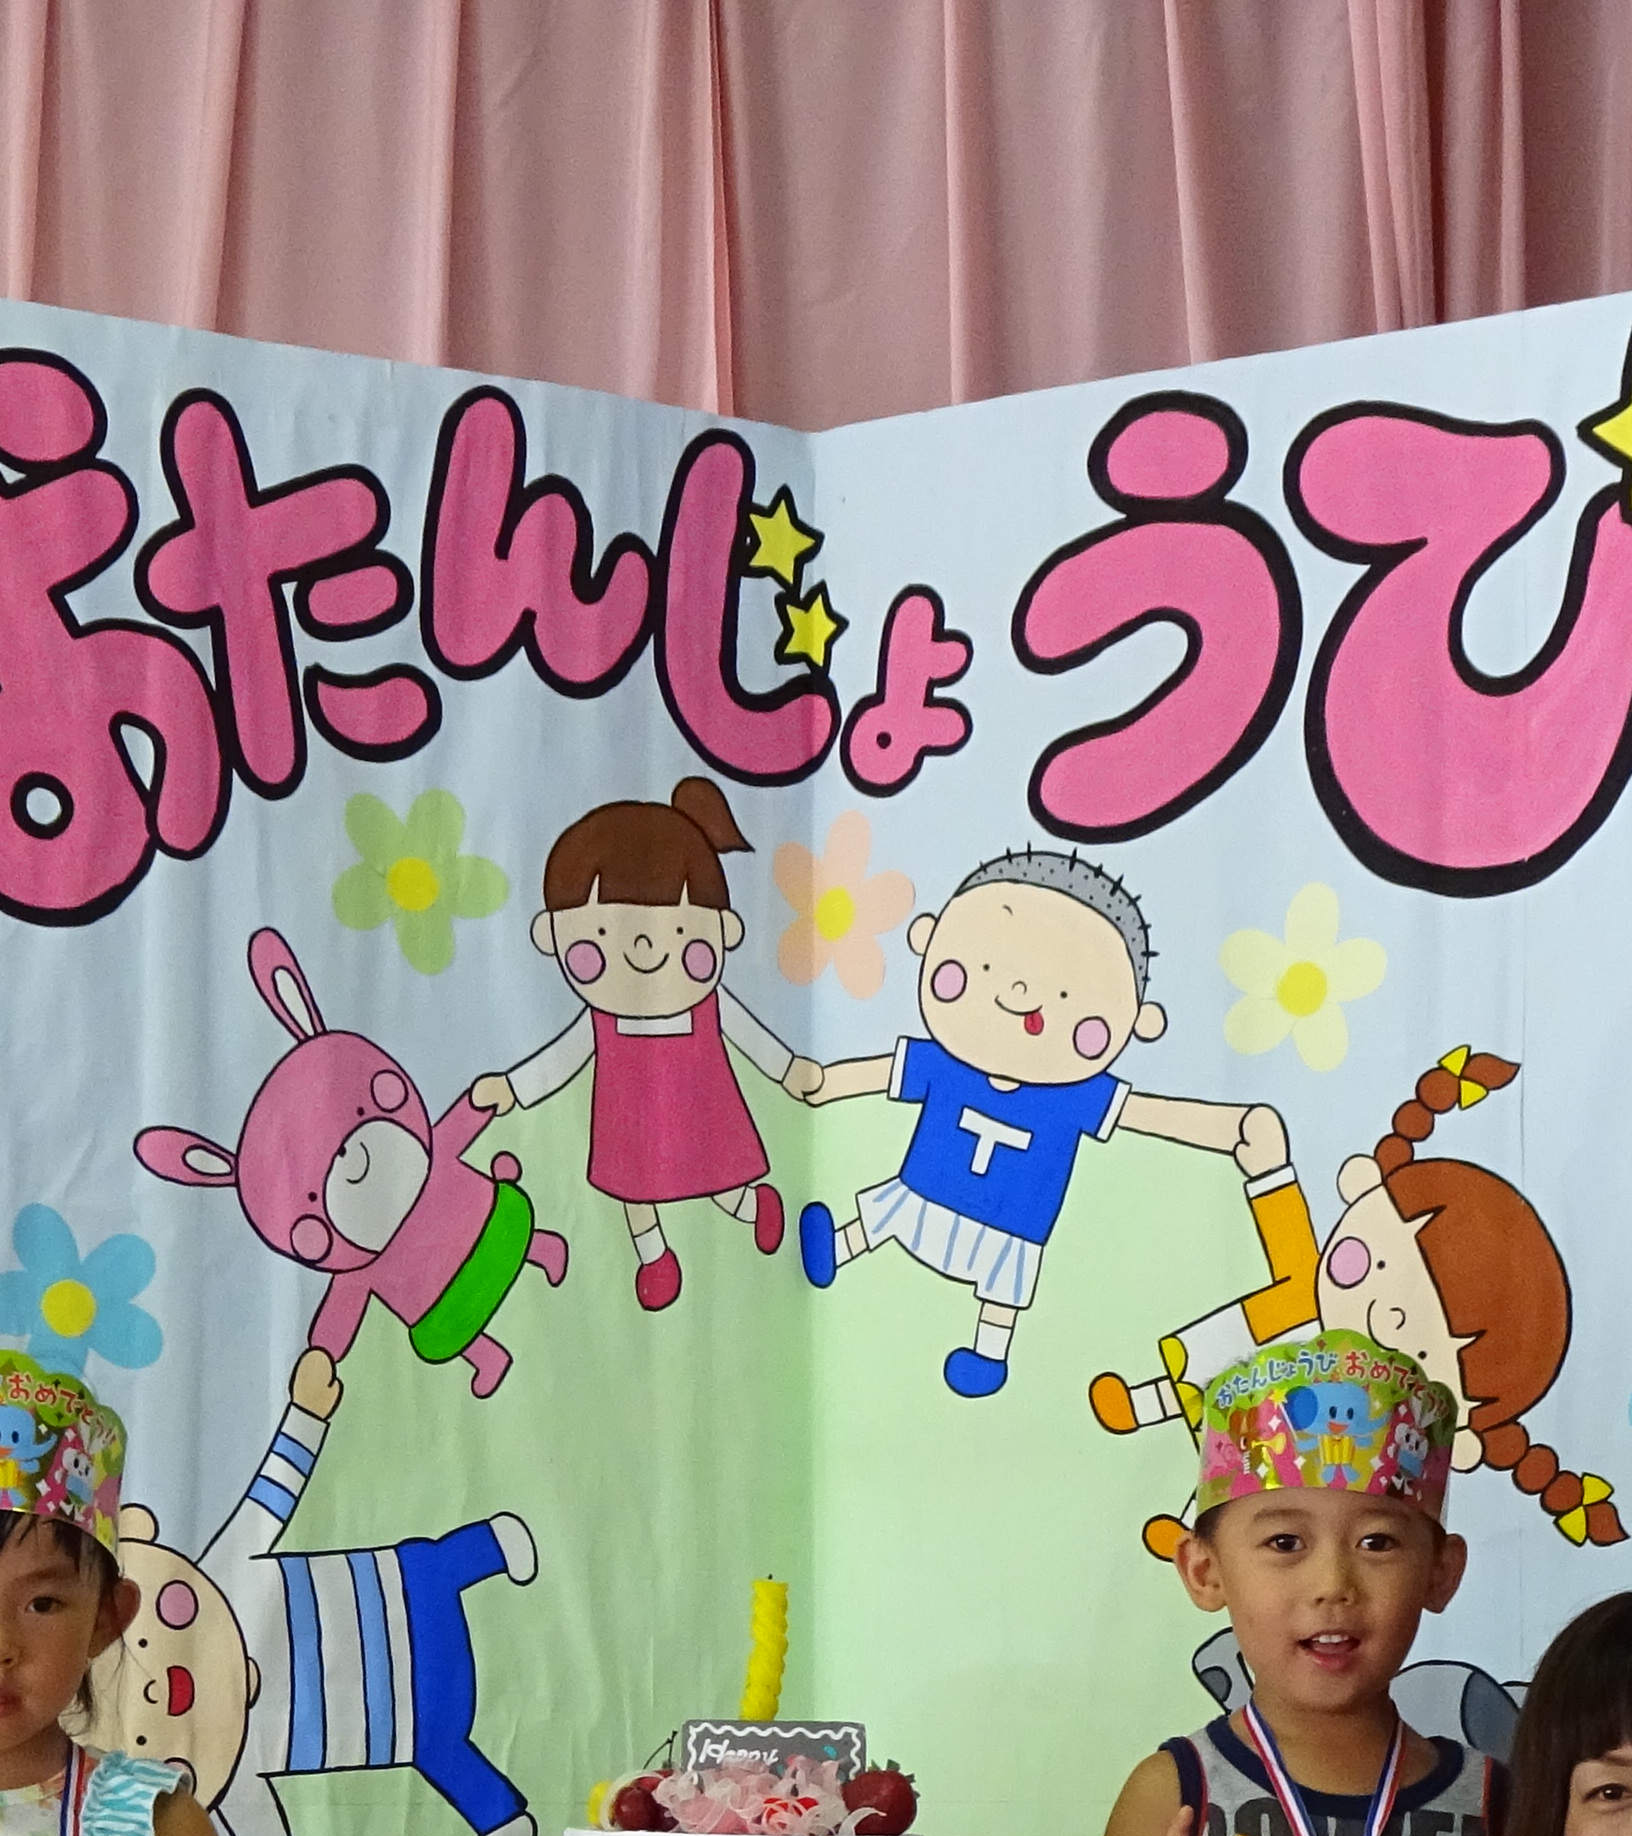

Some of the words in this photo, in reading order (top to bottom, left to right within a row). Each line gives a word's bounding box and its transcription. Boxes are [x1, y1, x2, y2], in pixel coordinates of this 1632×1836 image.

[958, 1106, 1033, 1176] T
[1217, 1352, 1338, 1409] おたんじょうび
